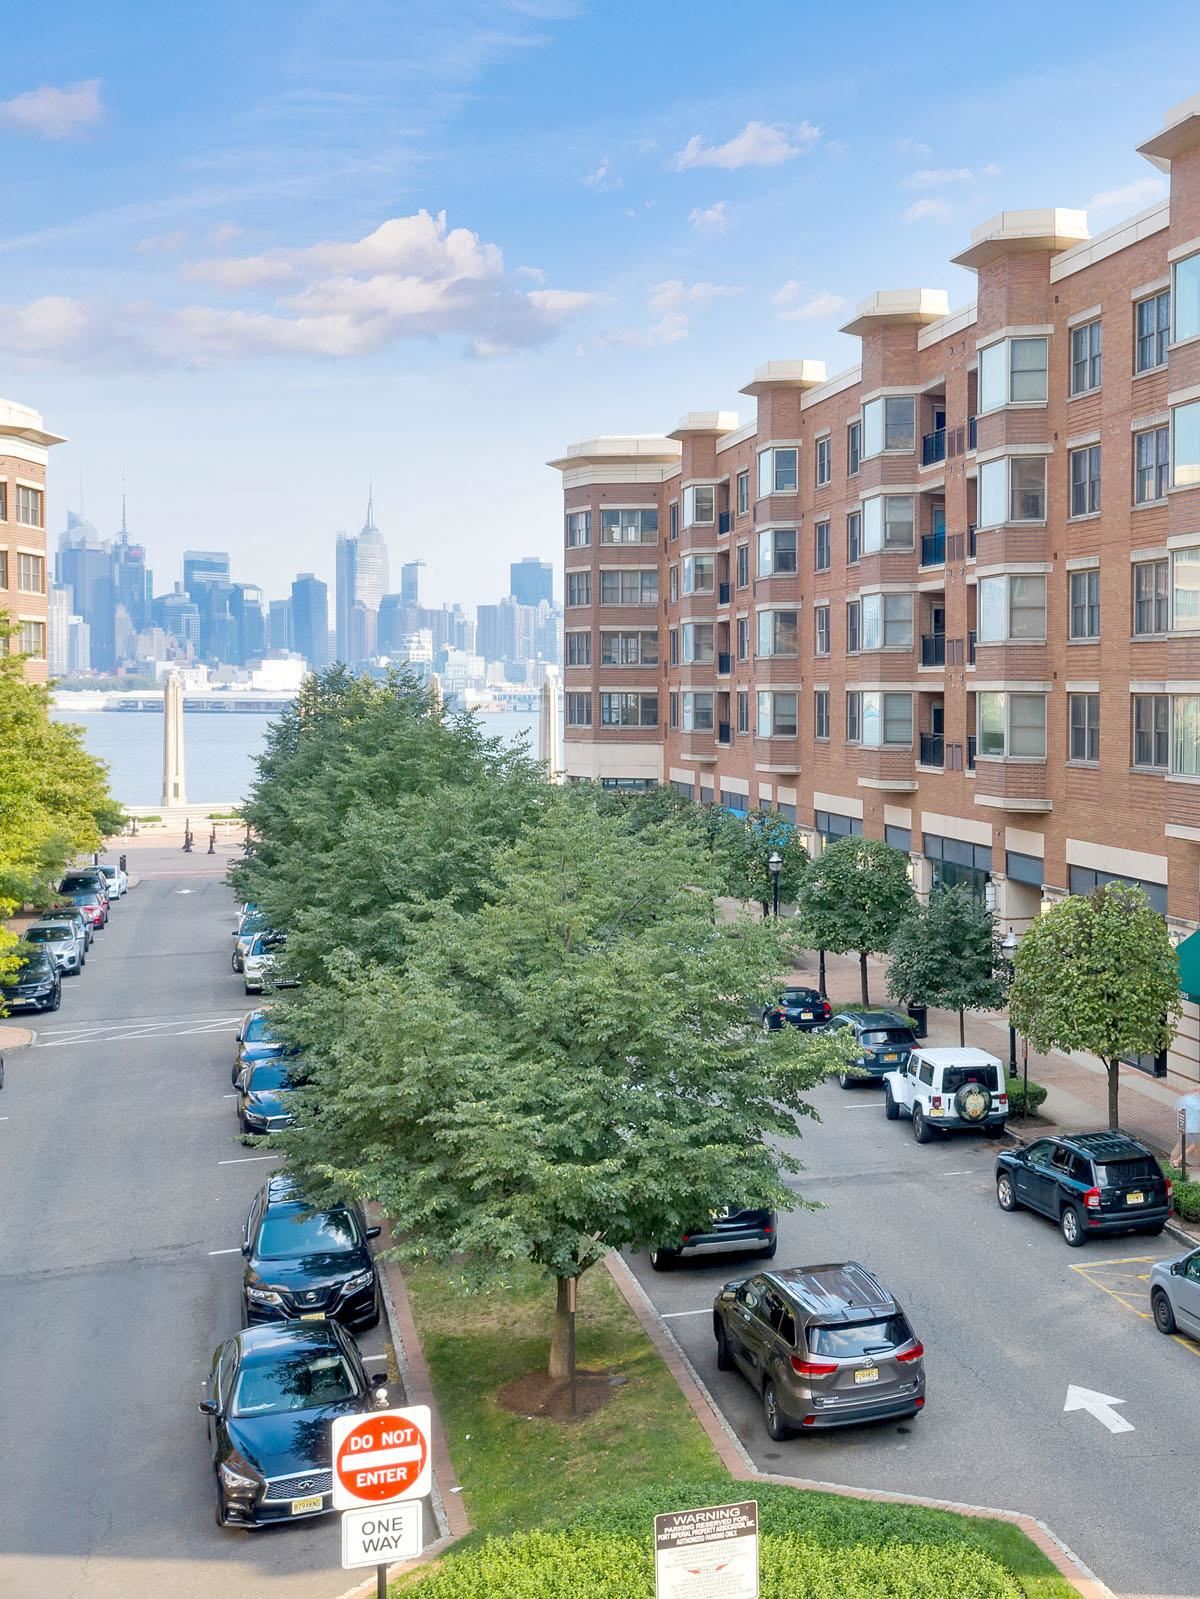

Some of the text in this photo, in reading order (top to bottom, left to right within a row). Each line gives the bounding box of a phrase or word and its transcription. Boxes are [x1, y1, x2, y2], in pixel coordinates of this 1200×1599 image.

[351, 1428, 414, 1451] DO NOT
[356, 1467, 408, 1488] ENTER
[664, 1515, 749, 1534] PARKING RESERVED FOR:
[673, 1507, 740, 1525] WARNING
[361, 1516, 403, 1536] ONE
[657, 1533, 671, 1541] PORT
[671, 1530, 691, 1539] IMPERIAL
[691, 1526, 716, 1536] PROPERTY
[362, 1534, 402, 1553] WAY
[676, 1535, 705, 1546] AUTHORIZED
[705, 1531, 725, 1541] PARKING
